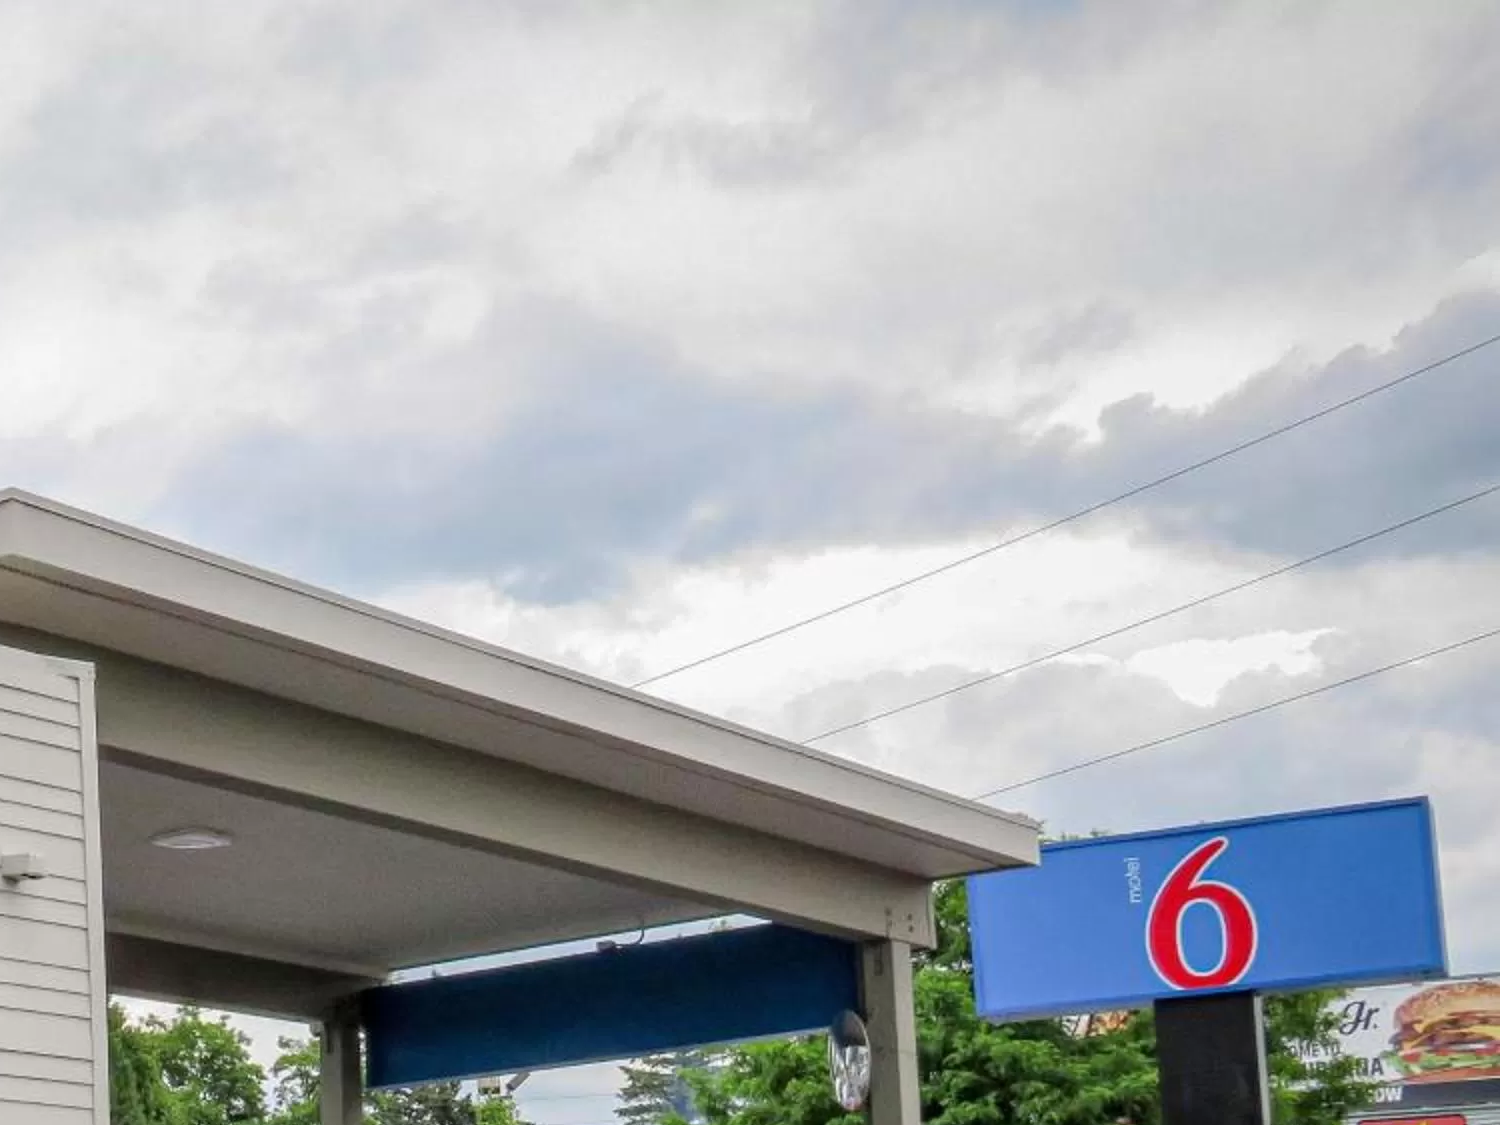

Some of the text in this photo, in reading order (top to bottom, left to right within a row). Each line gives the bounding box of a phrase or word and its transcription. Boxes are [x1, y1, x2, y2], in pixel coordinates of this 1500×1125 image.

[1123, 835, 1259, 991] motel 6
[1340, 1000, 1380, 1036] Jr.
